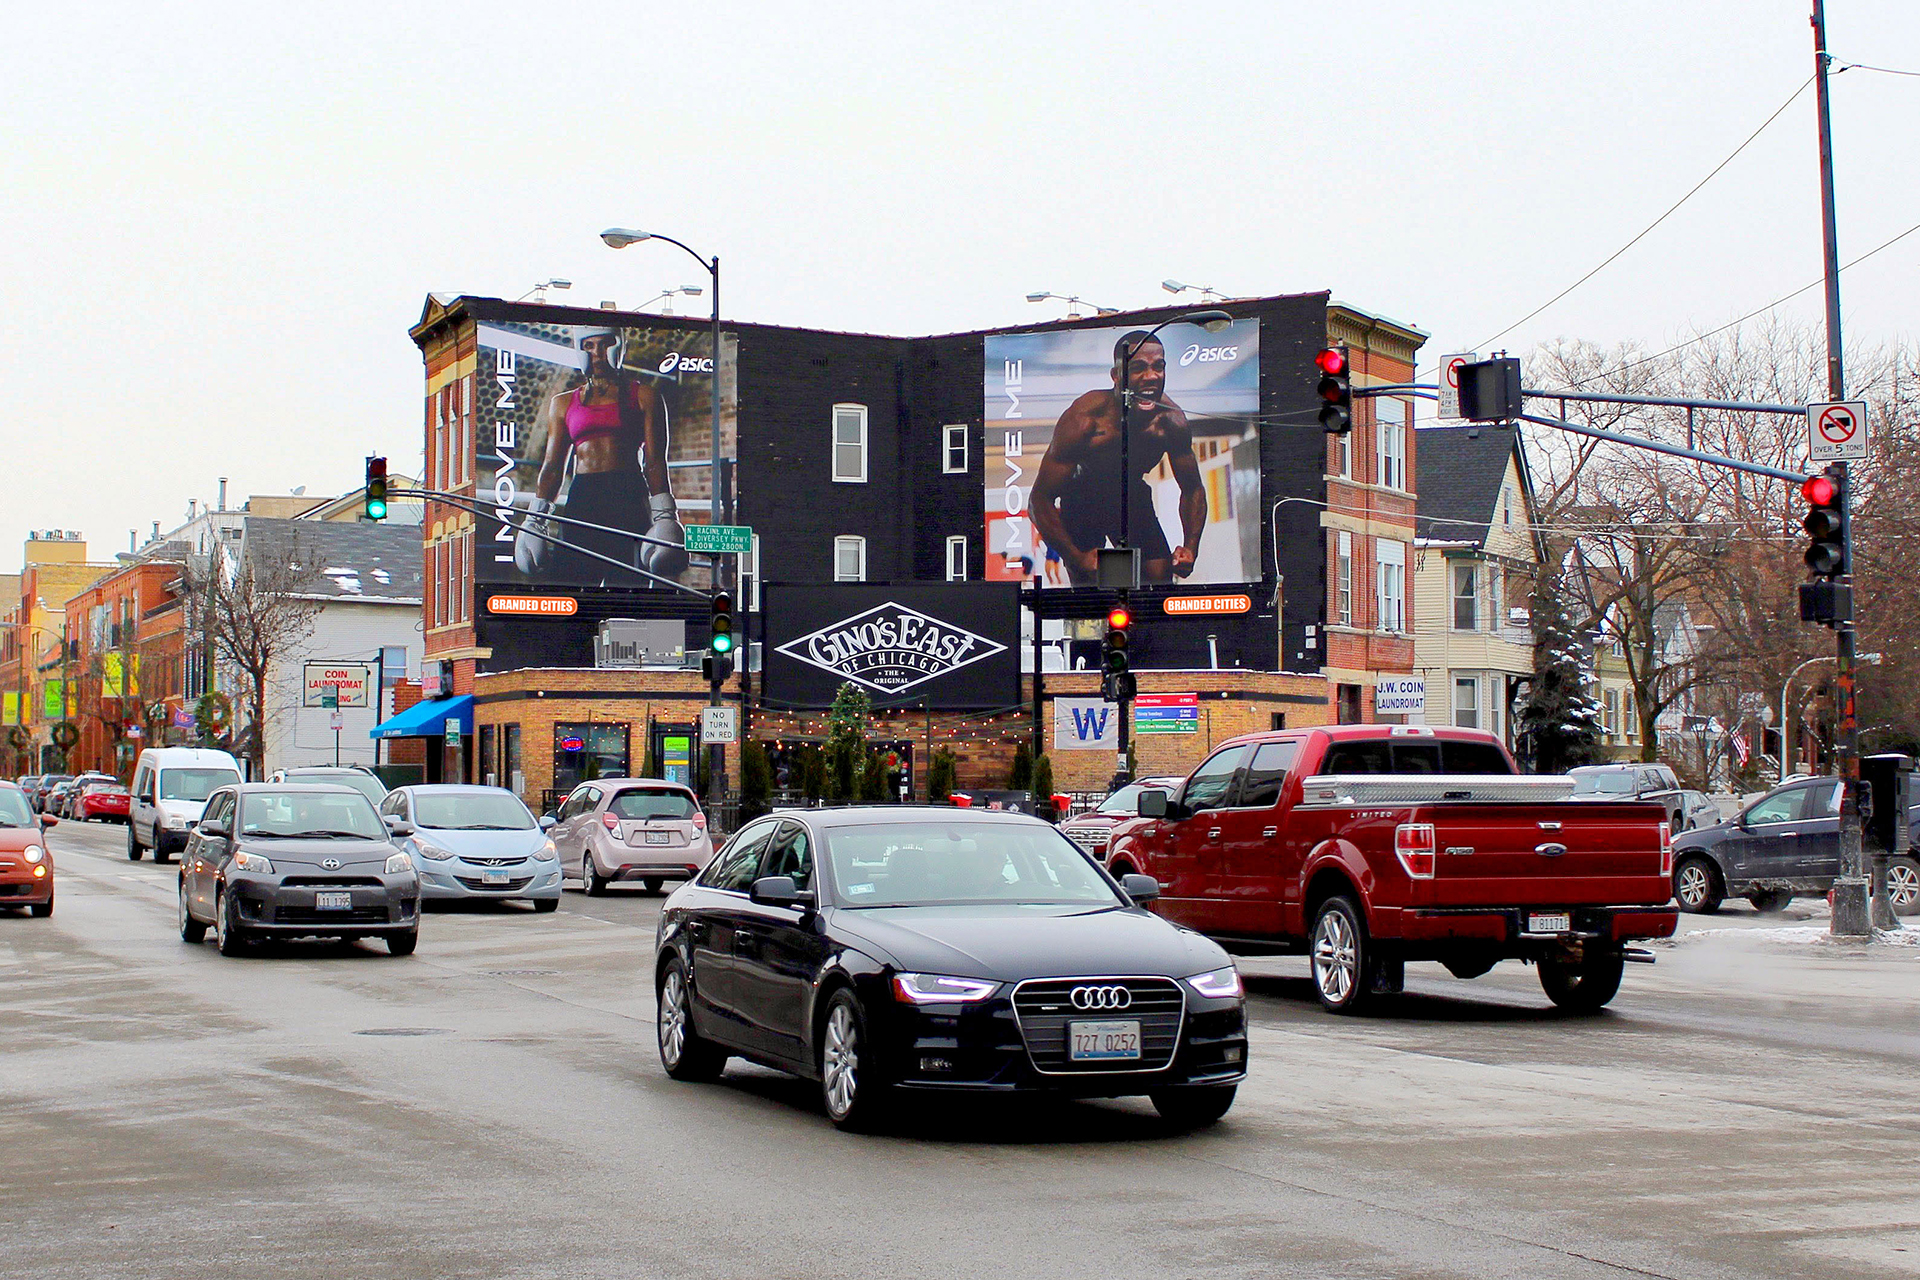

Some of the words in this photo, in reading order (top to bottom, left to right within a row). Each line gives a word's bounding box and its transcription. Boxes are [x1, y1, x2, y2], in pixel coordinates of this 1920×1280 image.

[1198, 346, 1239, 362] asics
[496, 348, 516, 409] ME
[1005, 359, 1023, 419] ME
[1813, 445, 1833, 453] OVER
[1835, 443, 1843, 454] 5
[1846, 443, 1864, 451] TONS
[495, 421, 515, 542] MOVE
[1005, 430, 1023, 548] MOVE
[722, 528, 738, 536] AVE.
[696, 535, 729, 543] DIVERSEY
[494, 554, 514, 563] I
[1005, 561, 1023, 569] I
[492, 598, 539, 611] BRANDED
[540, 600, 573, 612] CITIES
[1167, 599, 1212, 611] BRANDED
[1213, 598, 1246, 610] CITIES
[808, 617, 896, 666] GINO'S
[842, 659, 859, 675] OF
[867, 652, 940, 673] CHICAGO
[324, 670, 348, 679] COIN
[308, 680, 363, 689] LAUNDROMAT
[1377, 682, 1397, 693] J.W.
[1399, 681, 1424, 693] COIN
[1377, 698, 1424, 709] LAUNDROMAT
[712, 711, 725, 719] NO
[709, 721, 729, 729] TURN
[1071, 707, 1109, 740] W
[704, 730, 715, 738] ON
[718, 730, 733, 739] RED
[1350, 811, 1393, 819] LIMITED
[1539, 918, 1564, 930] 81171
[1105, 1033, 1137, 1052] 0252
